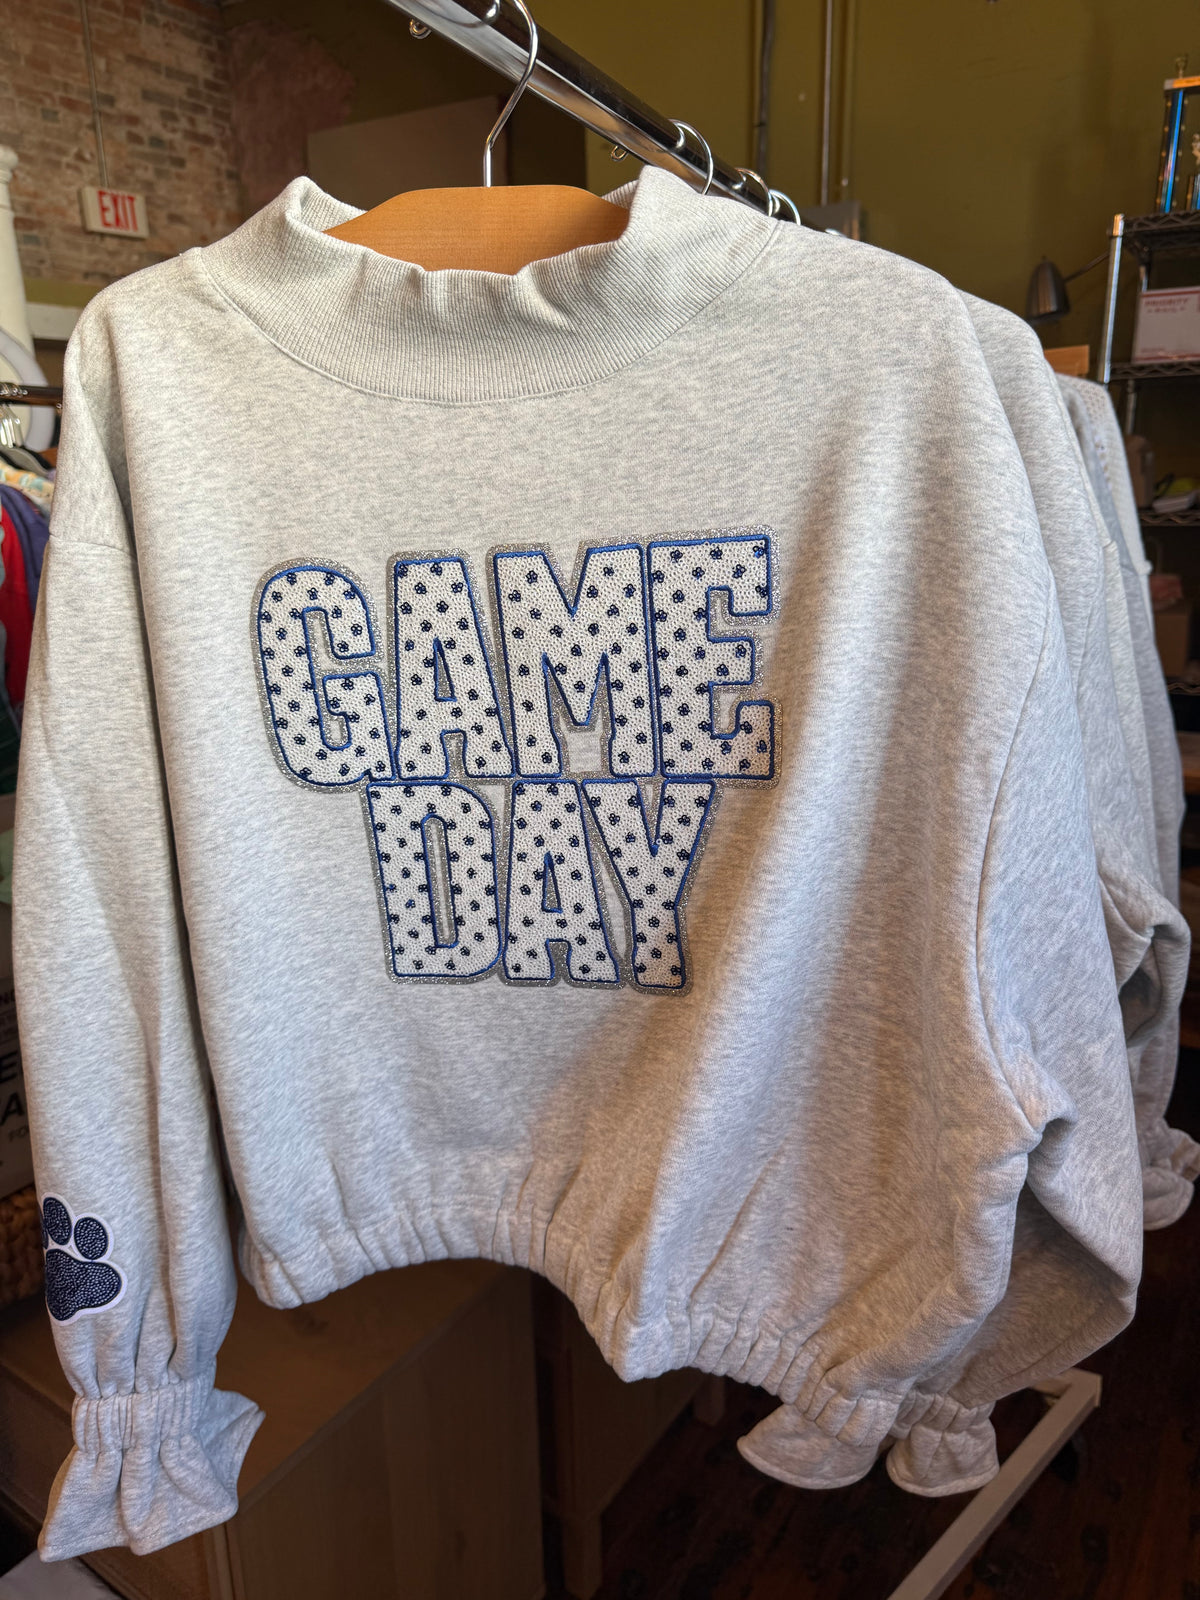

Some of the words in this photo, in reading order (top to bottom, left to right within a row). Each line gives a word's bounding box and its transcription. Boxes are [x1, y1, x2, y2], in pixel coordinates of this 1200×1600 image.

[97, 190, 138, 232] EXIT
[254, 530, 778, 787] GAME
[363, 778, 717, 990] DAY
